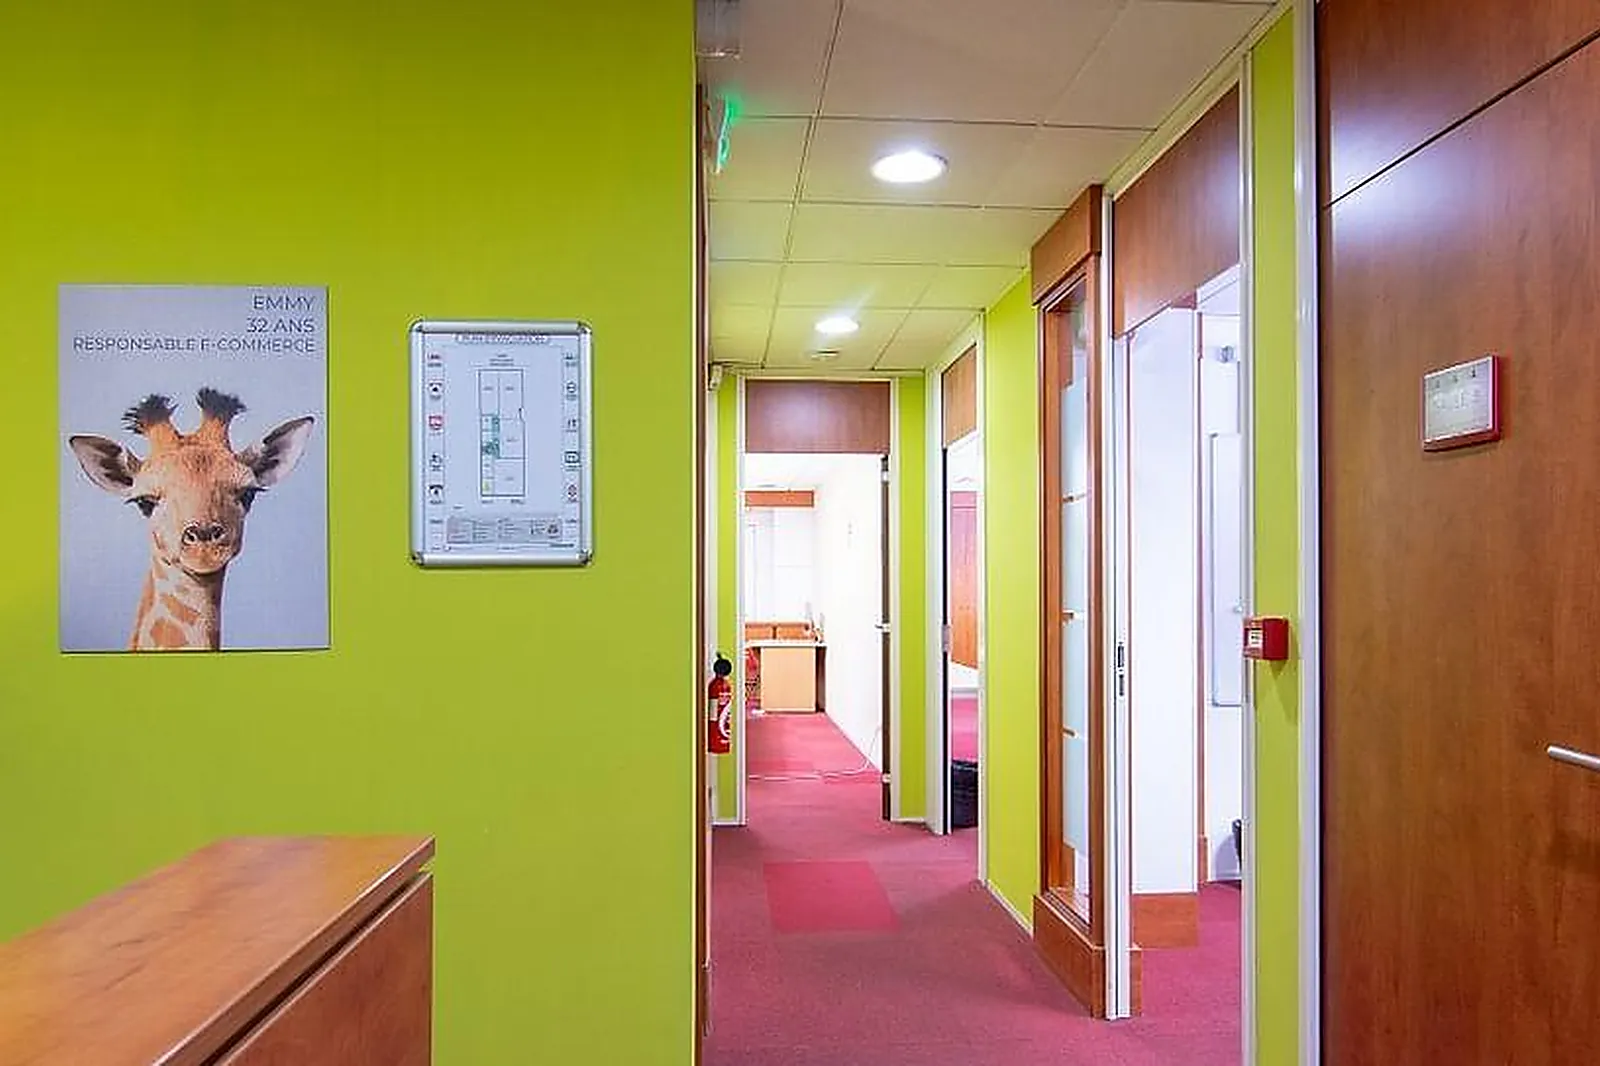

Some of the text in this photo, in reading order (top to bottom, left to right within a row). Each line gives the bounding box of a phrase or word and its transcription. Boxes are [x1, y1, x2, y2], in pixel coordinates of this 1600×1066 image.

[253, 296, 315, 310] EMMY
[247, 318, 315, 333] 32 ANS
[73, 338, 315, 352] RESPONSABLE E-COMMERCE
